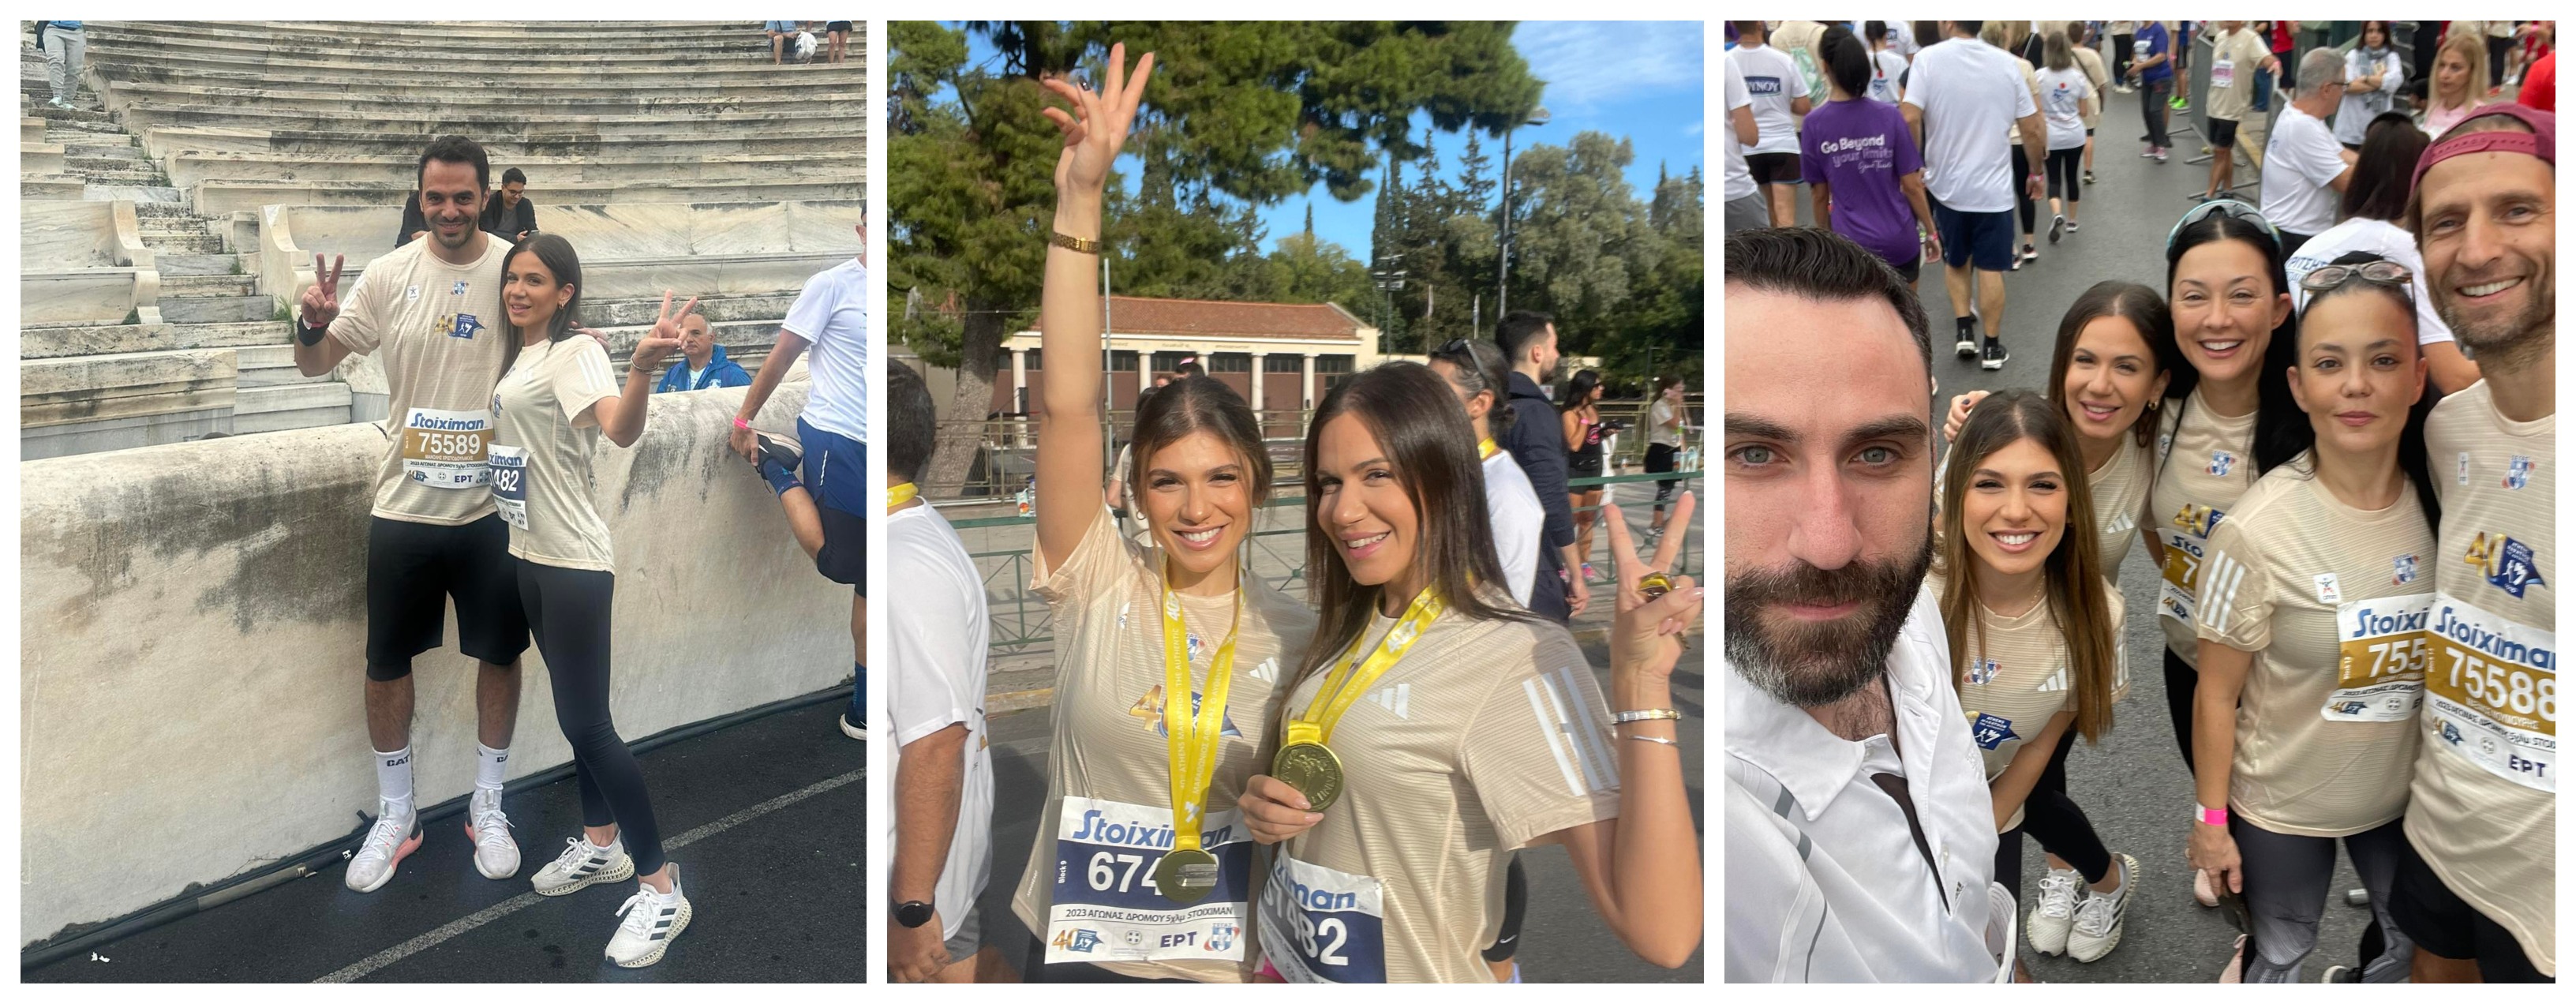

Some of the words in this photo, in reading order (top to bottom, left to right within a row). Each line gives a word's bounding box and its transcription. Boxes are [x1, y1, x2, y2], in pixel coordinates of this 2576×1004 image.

[1821, 141, 1839, 154] Go
[1839, 133, 1885, 151] Beyond
[1833, 152, 1860, 167] your
[1863, 146, 1893, 159] limits
[410, 413, 485, 430] Stoiximan
[418, 432, 481, 455] 75589
[2435, 606, 2555, 670] Stoixima
[1172, 628, 1183, 672] AUTHENTIC
[2446, 646, 2555, 721] 75588
[1073, 810, 1232, 849] Stoixian
[1058, 866, 1067, 884] Block
[1088, 852, 1219, 895] 674
[1088, 910, 1123, 920] ΑΓΩΝΑΣ
[1126, 913, 1164, 923] ΔΡΟΜΟΥ
[1166, 915, 1185, 923] 5χλμ
[1187, 907, 1233, 920] STOIXIMAN
